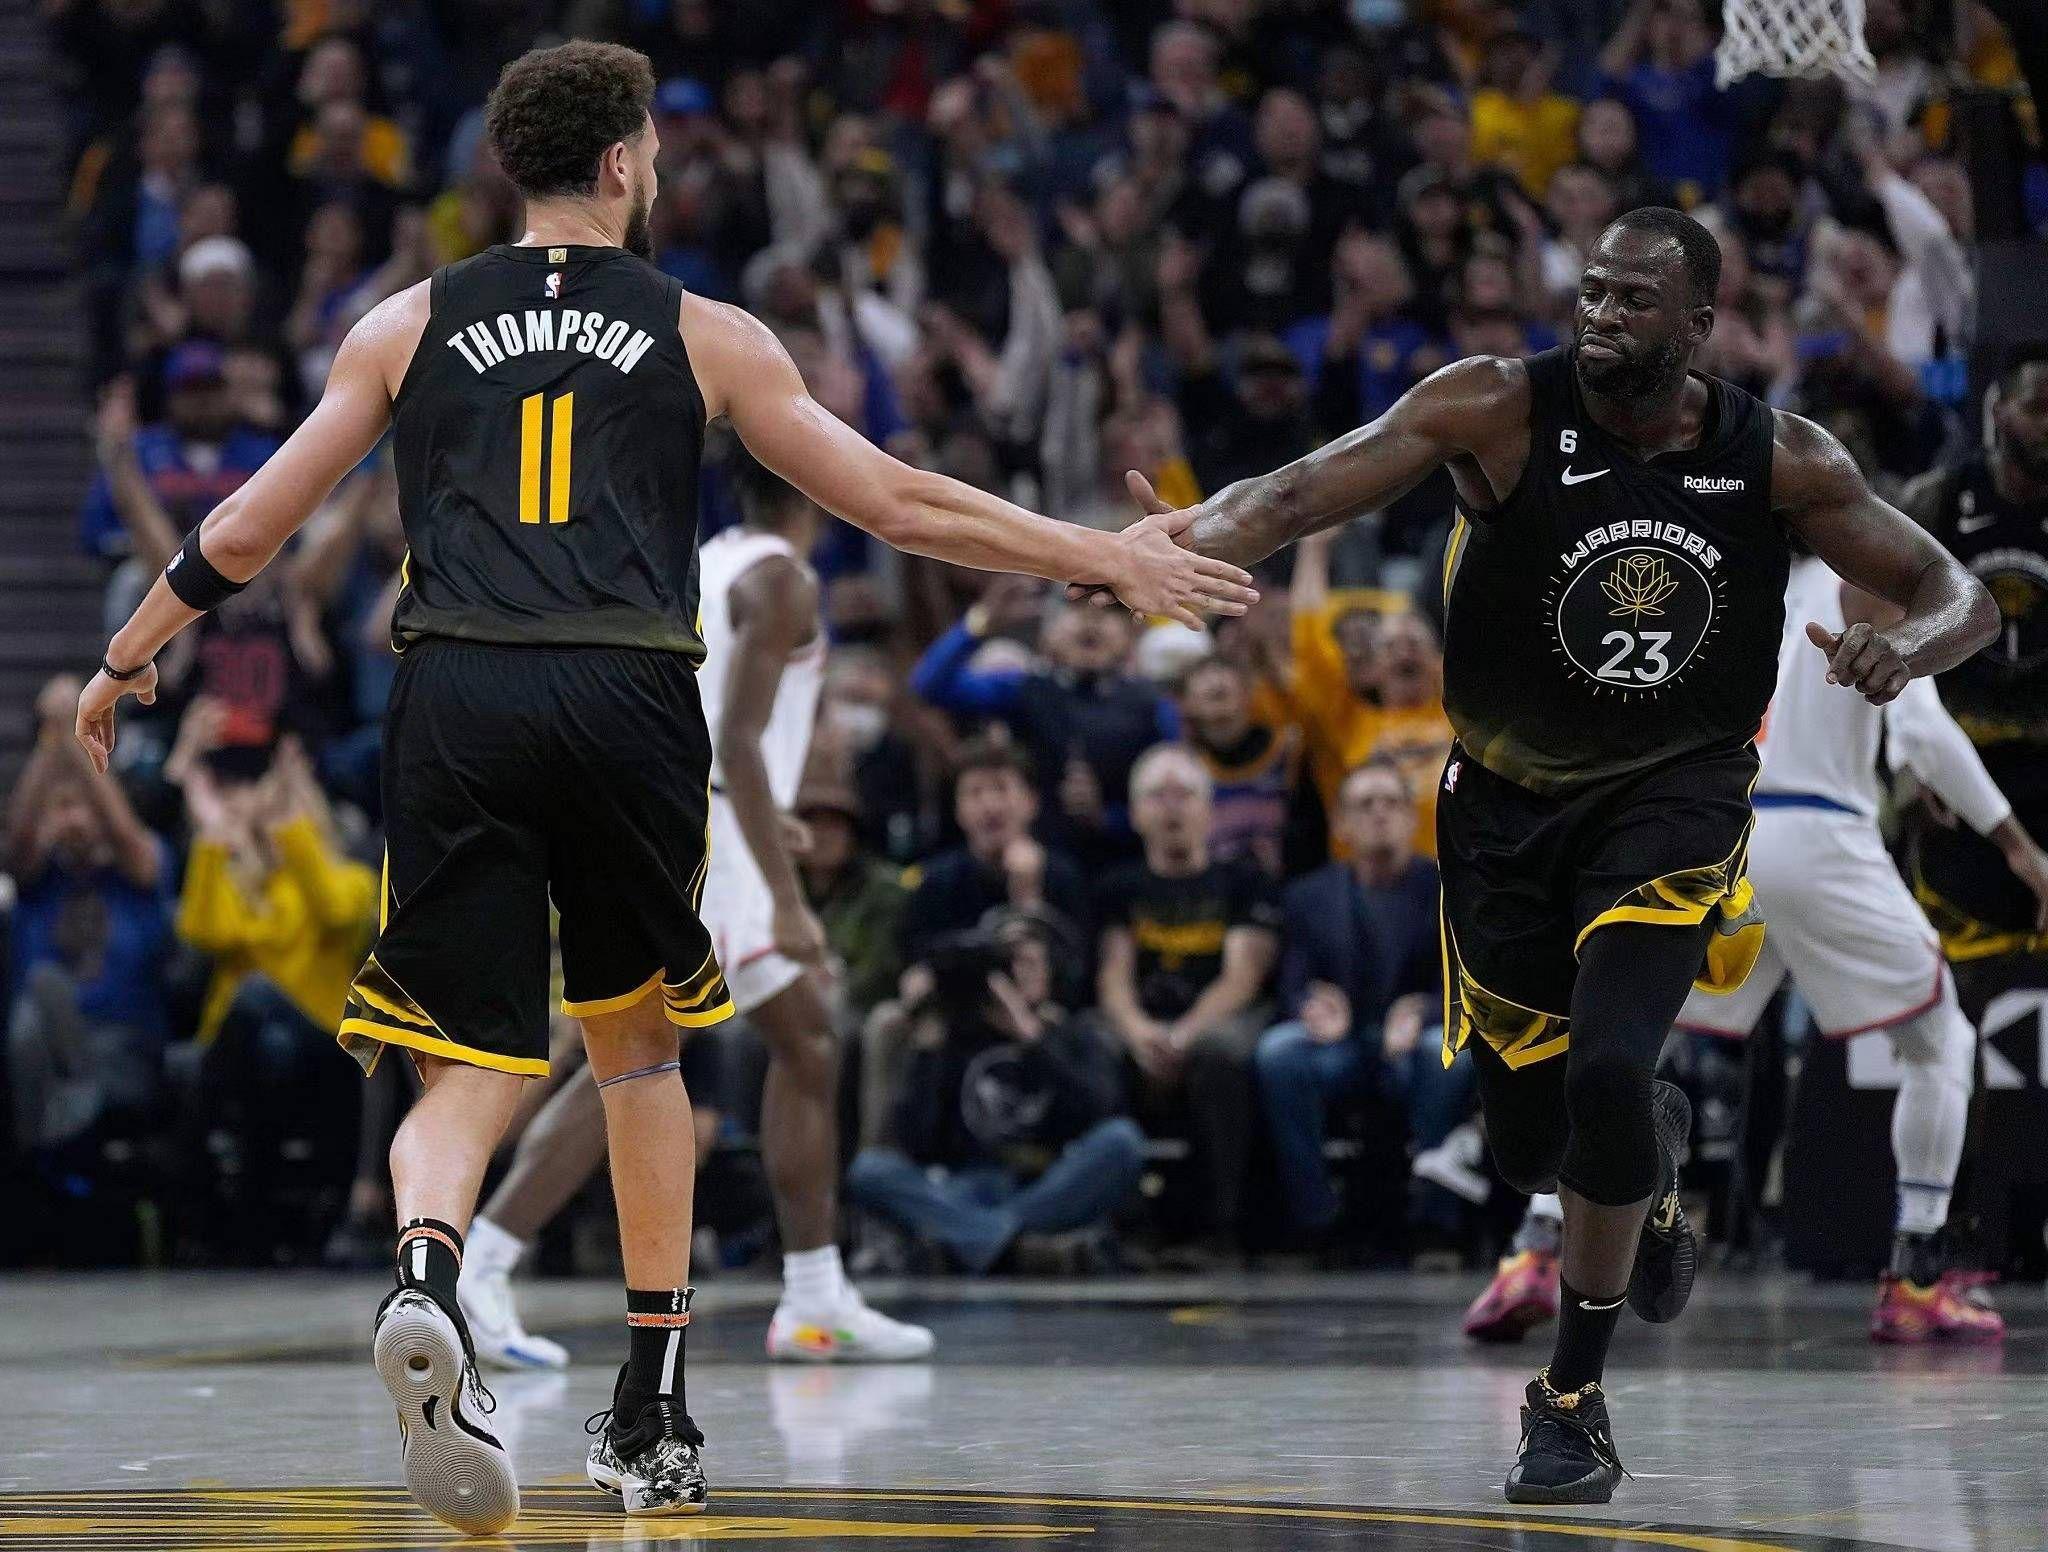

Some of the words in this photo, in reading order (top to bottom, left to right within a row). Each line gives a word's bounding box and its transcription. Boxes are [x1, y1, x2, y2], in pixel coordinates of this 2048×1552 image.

[447, 310, 655, 374] THOMPSON
[520, 392, 574, 523] 11
[1559, 430, 1578, 453] 6
[1684, 475, 1744, 492] Rakuten
[1561, 519, 1722, 569] WARRIORS
[1596, 630, 1672, 682] 23
